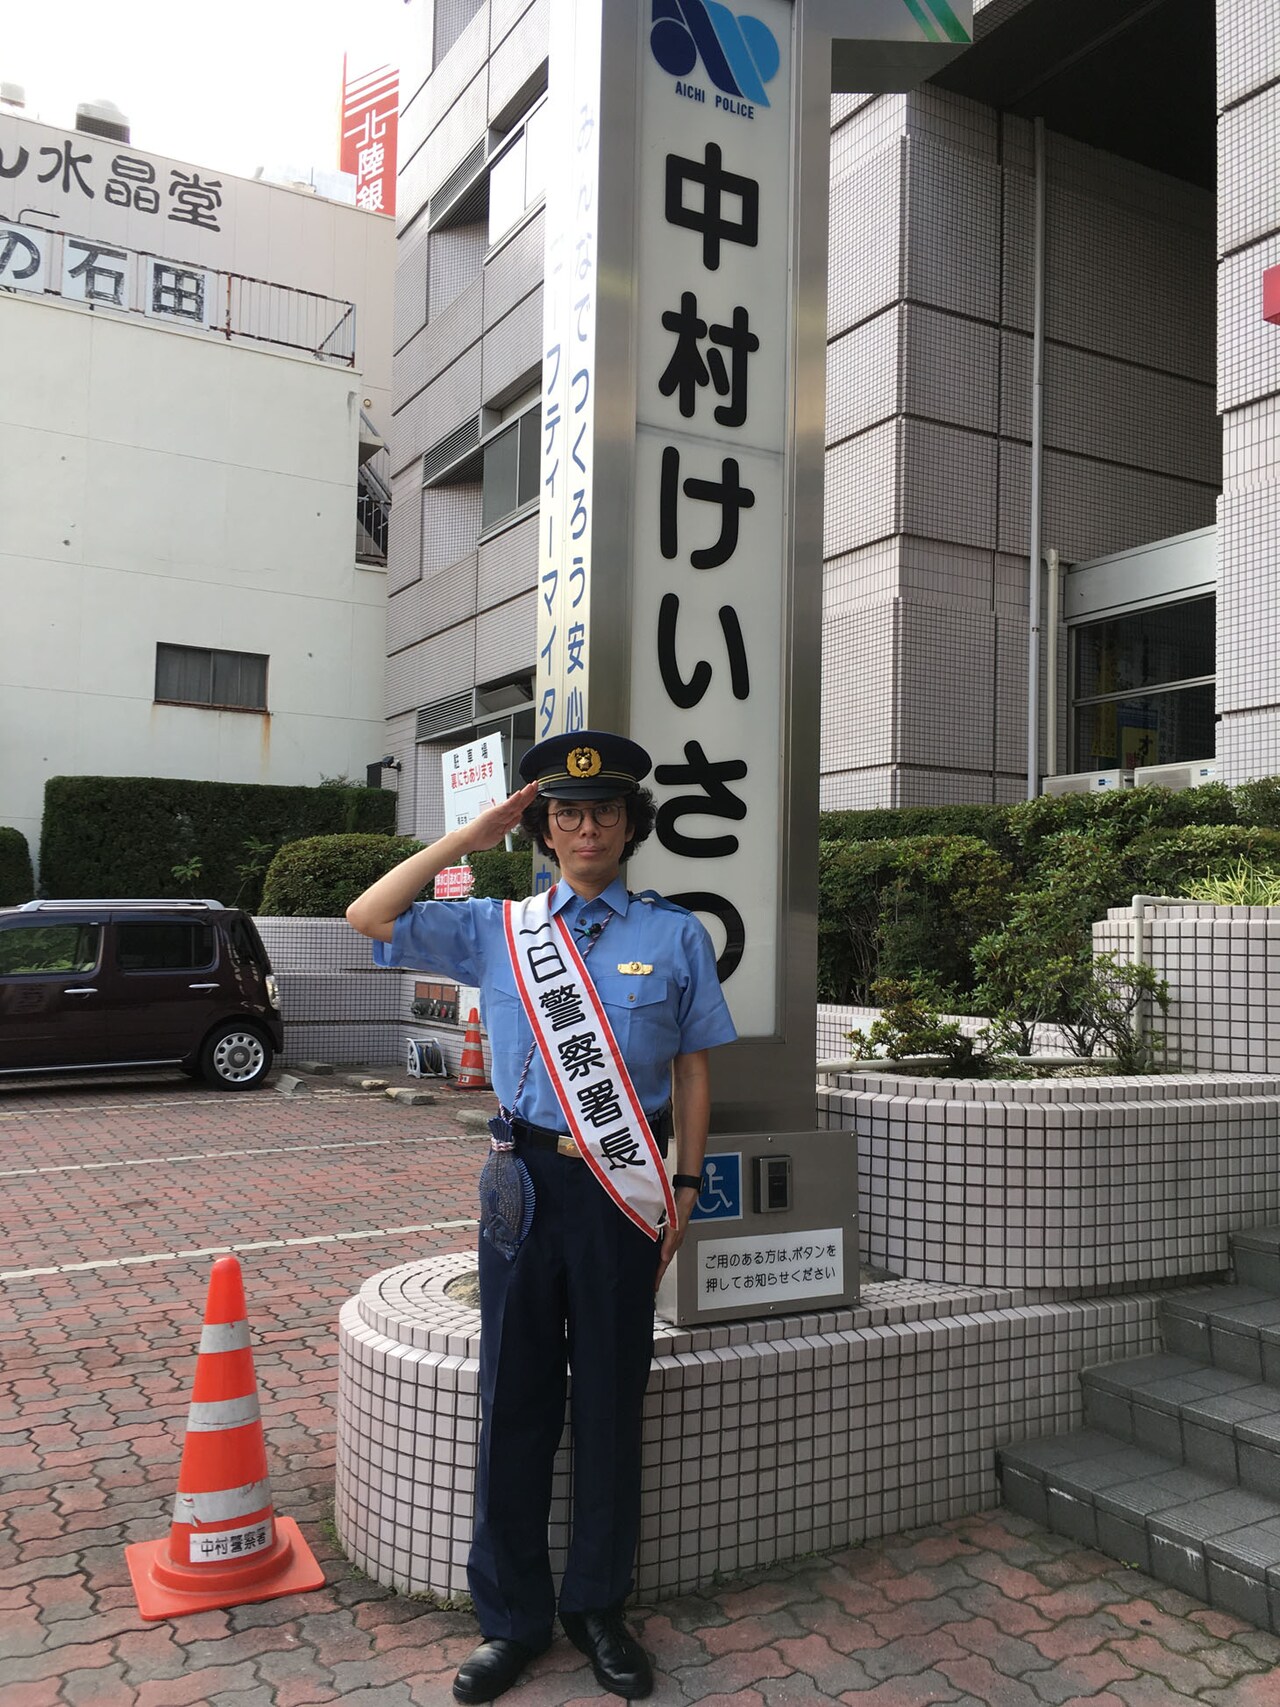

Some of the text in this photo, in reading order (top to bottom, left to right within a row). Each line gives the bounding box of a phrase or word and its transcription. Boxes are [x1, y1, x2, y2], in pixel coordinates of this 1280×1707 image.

[675, 81, 754, 120] AICHI POLICE
[354, 110, 387, 211] 北陸銀
[519, 922, 647, 1170] 一日警察署長
[705, 1244, 836, 1269] ご用のある方は、ボタンを
[706, 1266, 836, 1293] 押してお知らせください
[201, 1526, 266, 1557] 中村警察署
